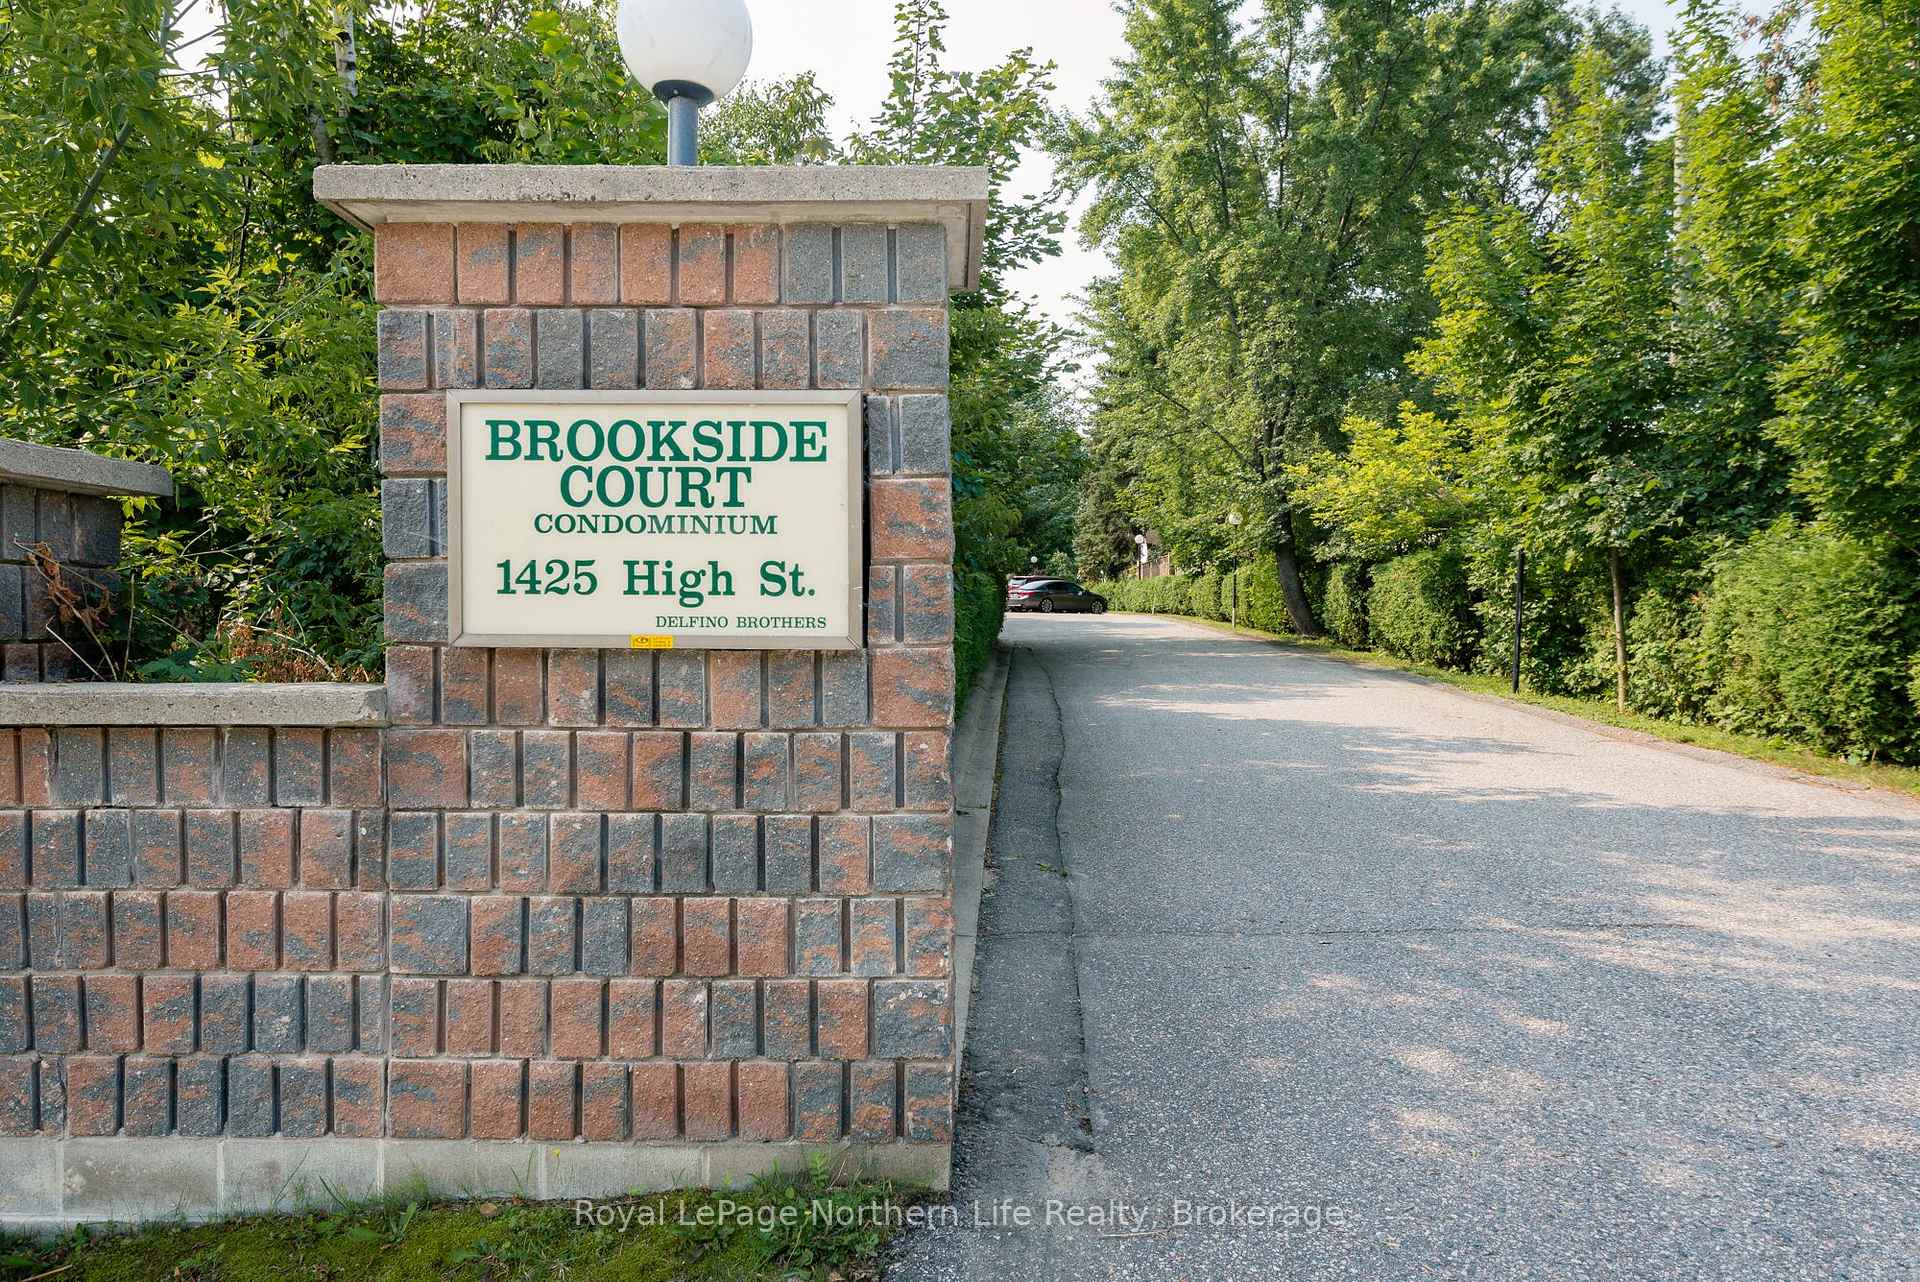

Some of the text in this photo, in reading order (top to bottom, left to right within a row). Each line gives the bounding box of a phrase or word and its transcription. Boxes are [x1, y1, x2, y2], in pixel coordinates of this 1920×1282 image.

[485, 419, 827, 462] BROOKSIDE
[560, 465, 752, 508] COURT
[534, 514, 777, 534] CONDOMINIUM
[497, 559, 815, 608] 1425 High St.
[656, 616, 826, 628] DELFINO BROTHERS
